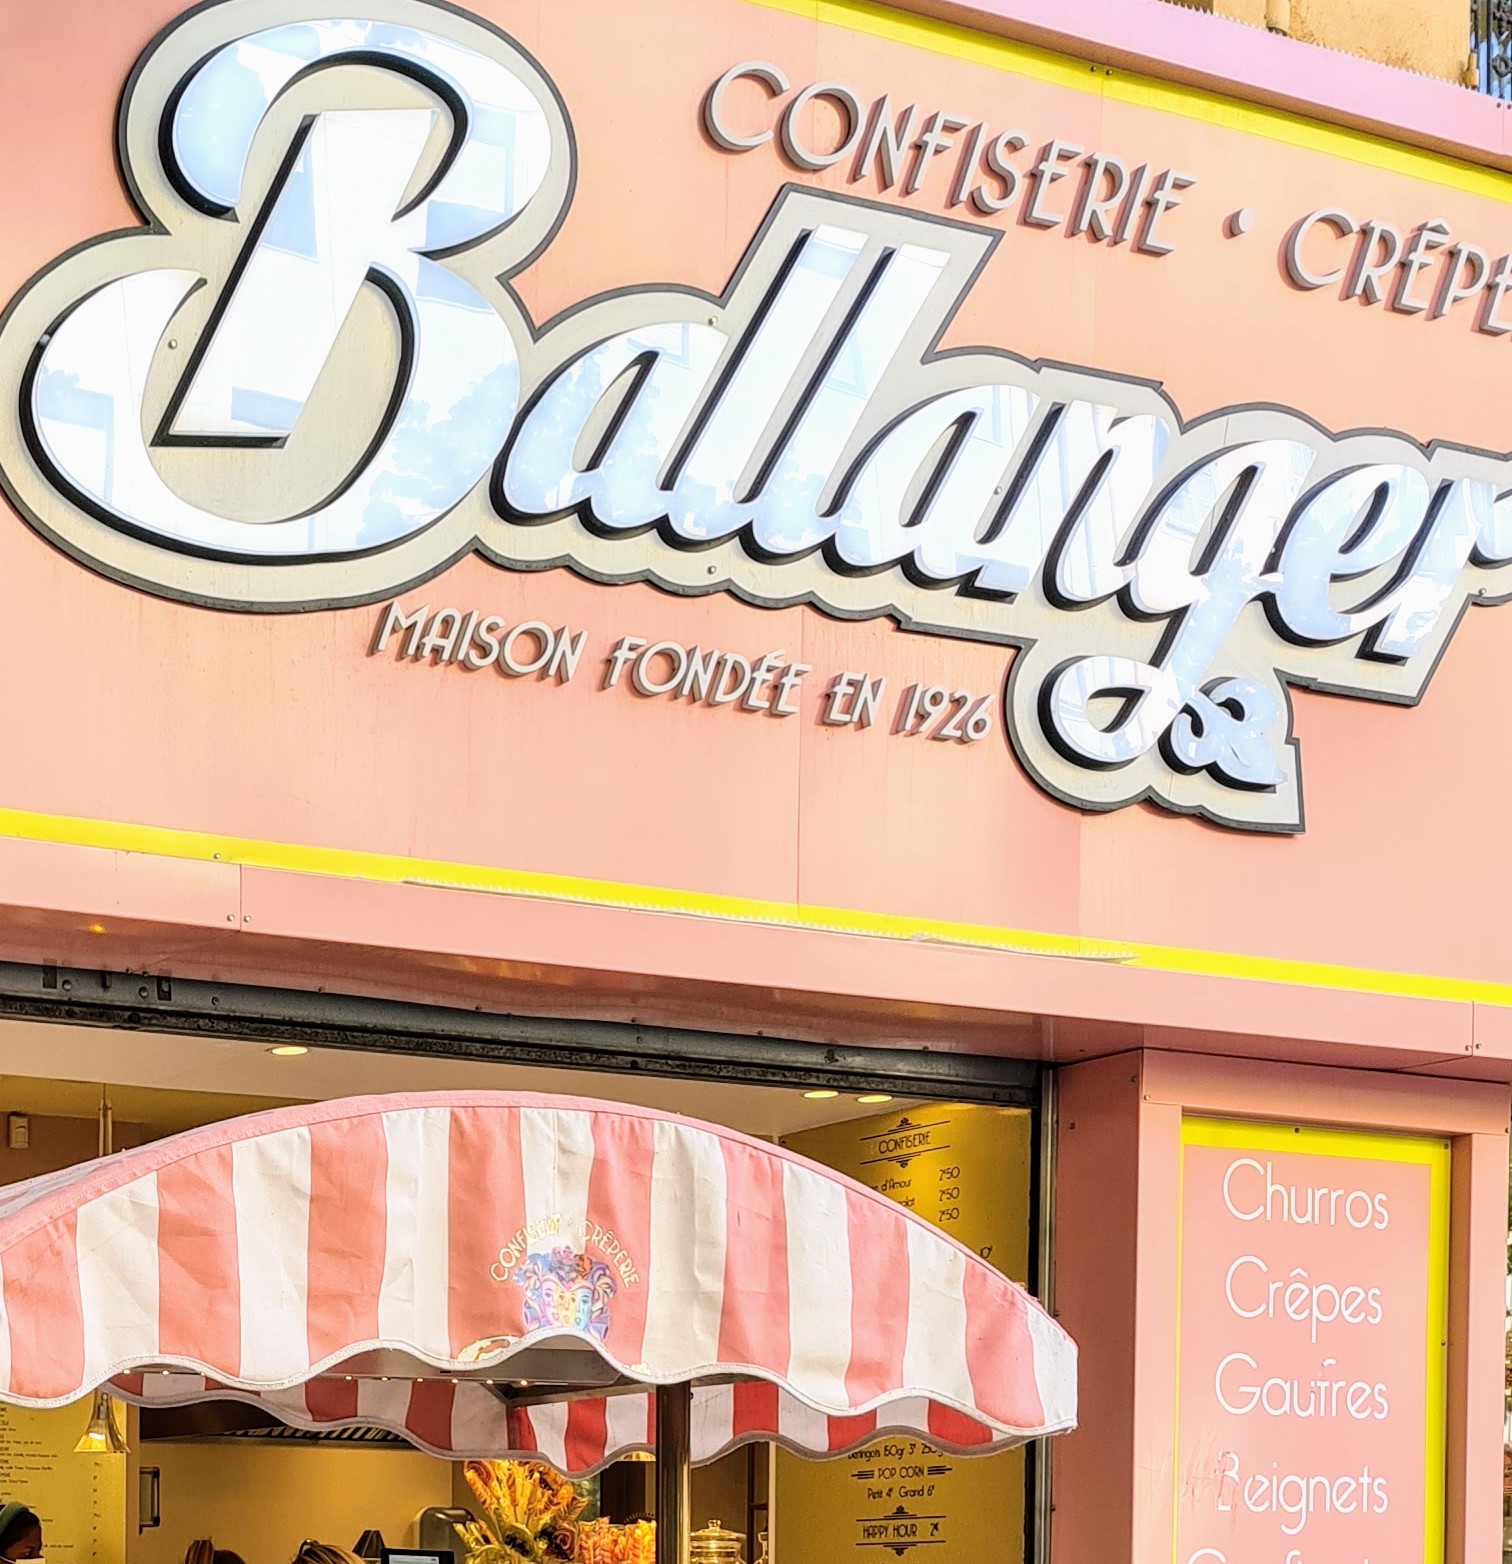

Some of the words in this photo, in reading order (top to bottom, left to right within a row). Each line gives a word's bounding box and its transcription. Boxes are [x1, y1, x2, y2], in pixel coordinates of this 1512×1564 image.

[698, 60, 1197, 256] CONFISERIE
[368, 601, 588, 684] MAISON
[600, 633, 812, 717] FONDÉE
[819, 671, 888, 728] EN
[895, 682, 995, 742] 1926
[879, 1131, 931, 1154] CONFISERIE
[1223, 1158, 1389, 1230] Churros
[578, 1220, 639, 1289] CRÊPERIE
[1226, 1255, 1382, 1343] Crêpes
[878, 1467, 897, 1479] POP
[899, 1465, 925, 1478] CORN
[899, 1485, 925, 1498] Grand
[862, 1524, 889, 1539] HAPPY
[893, 1523, 918, 1538] HOUR
